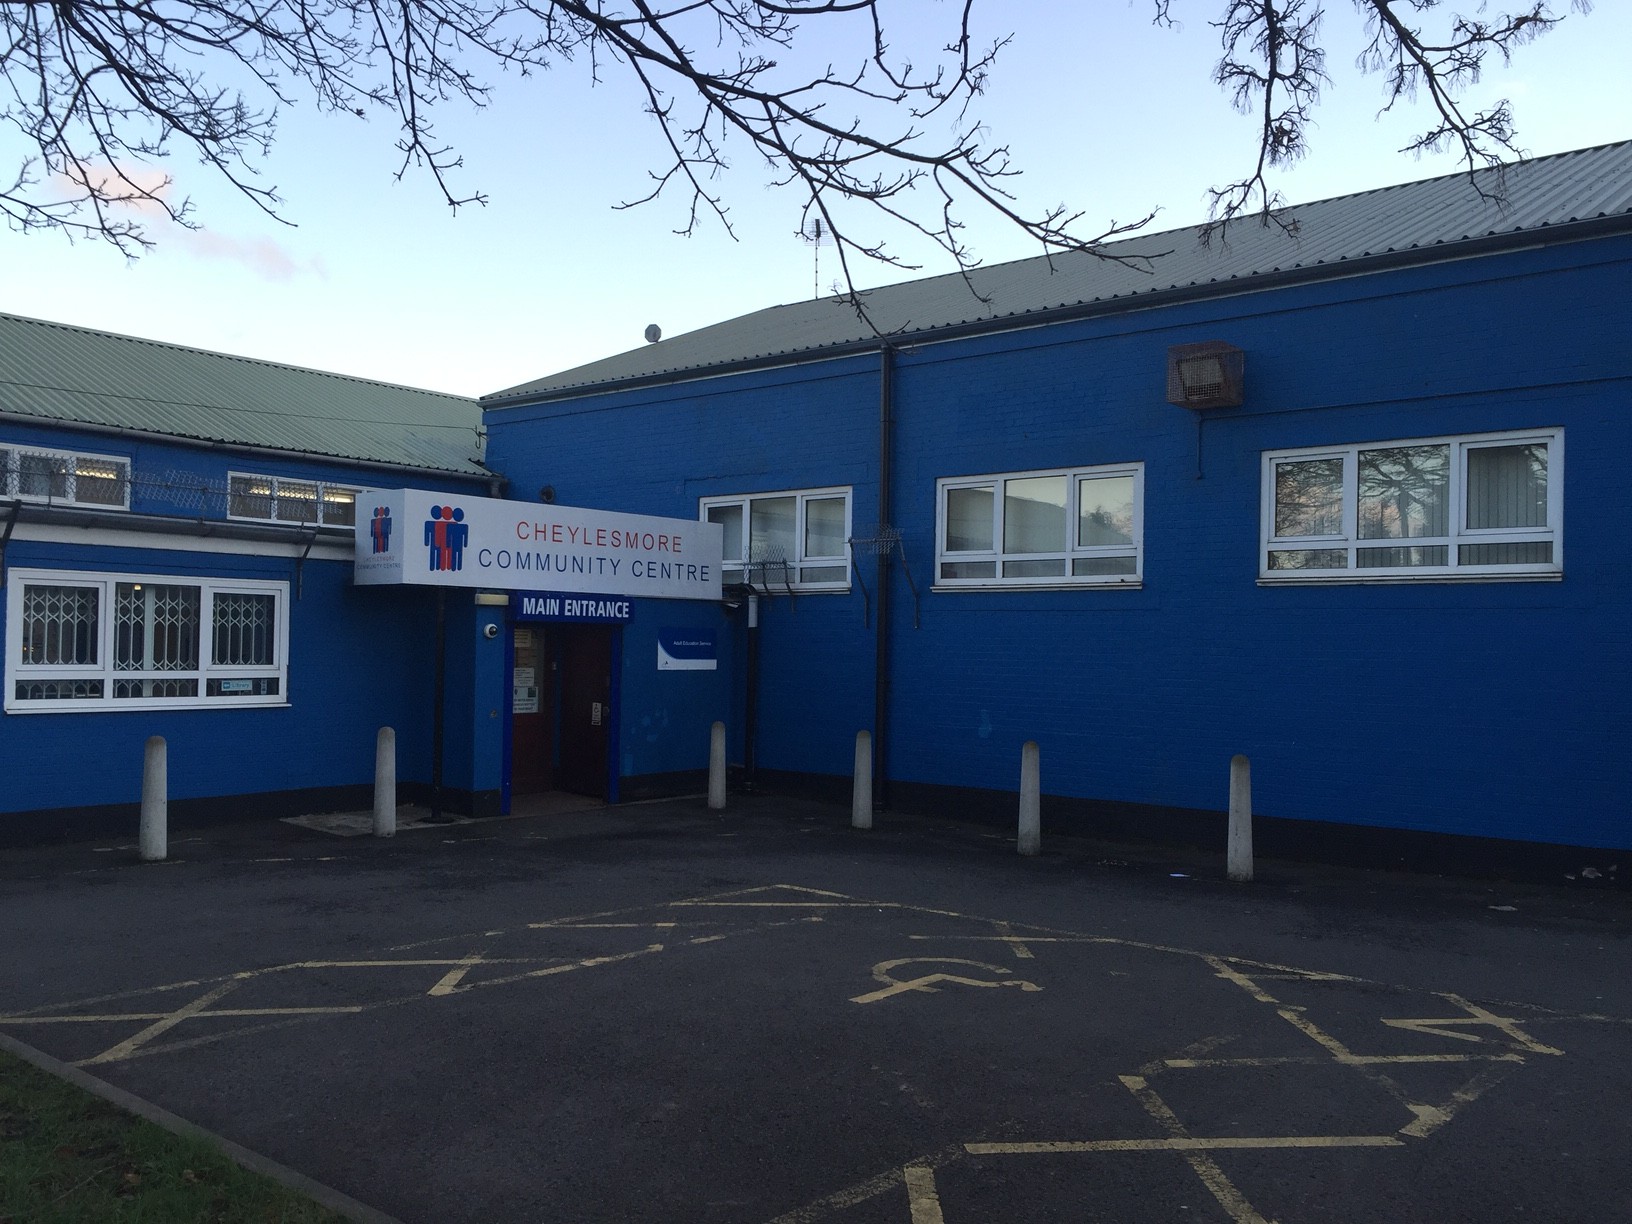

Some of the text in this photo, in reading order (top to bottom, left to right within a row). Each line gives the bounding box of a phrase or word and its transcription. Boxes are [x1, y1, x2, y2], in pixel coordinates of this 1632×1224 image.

[517, 521, 682, 553] CHEYLESMORE
[479, 548, 710, 582] COMMUNITY CENTRE
[523, 597, 630, 618] MAIN ENTRANCE
